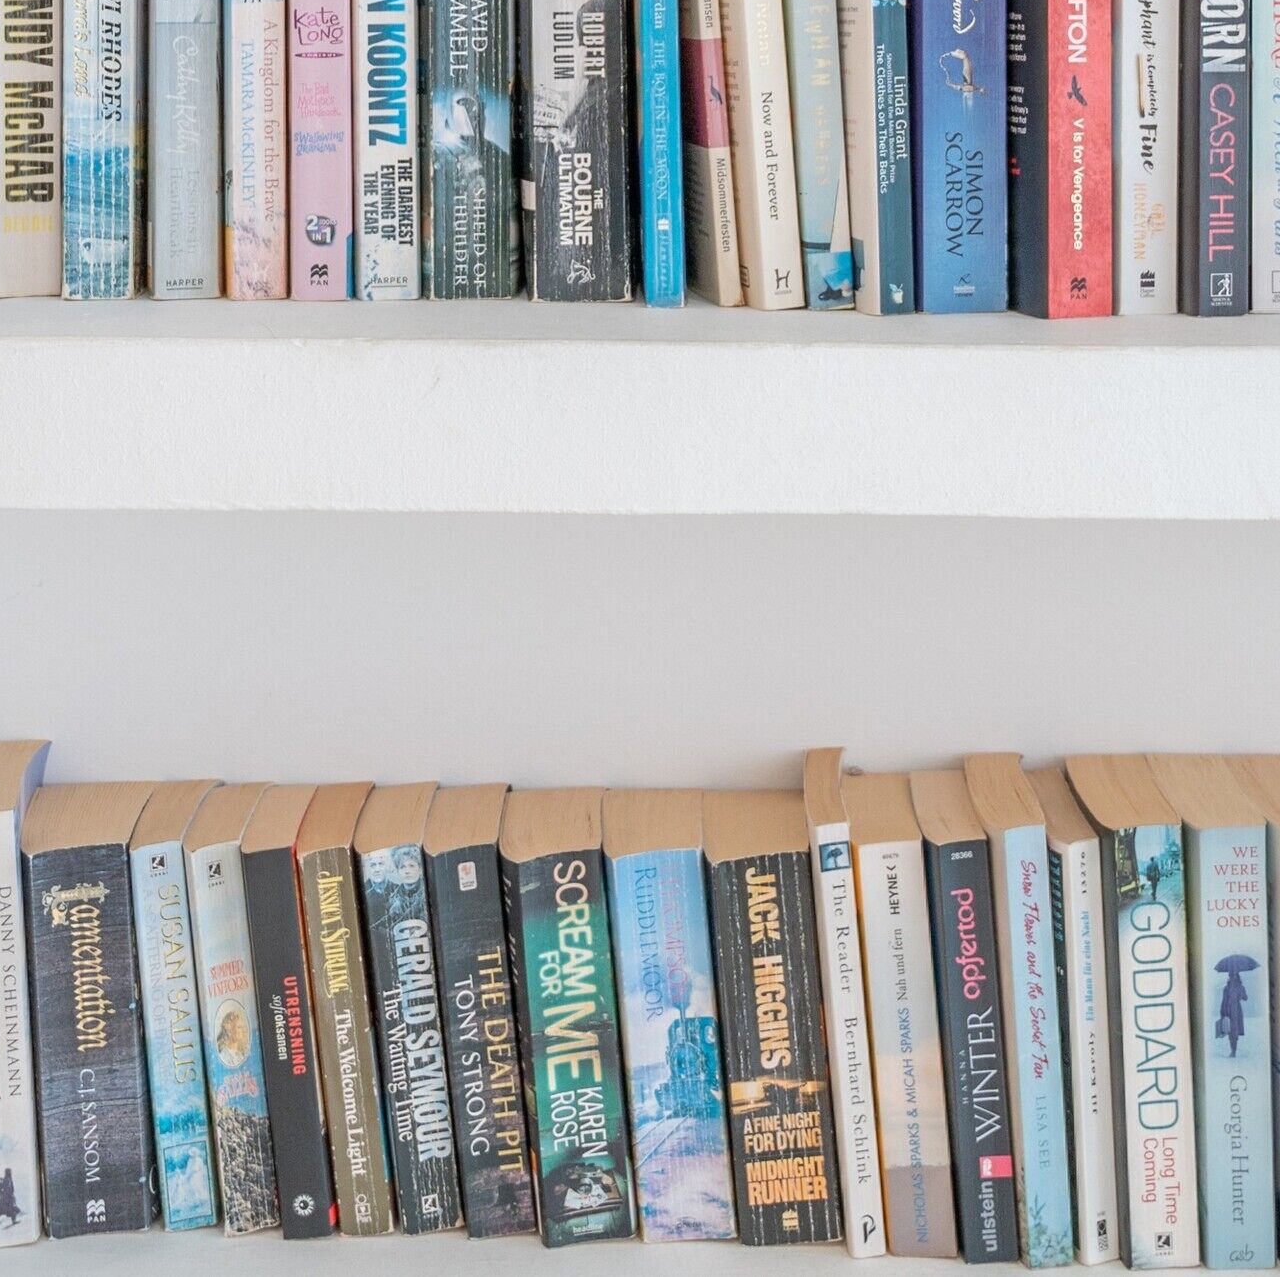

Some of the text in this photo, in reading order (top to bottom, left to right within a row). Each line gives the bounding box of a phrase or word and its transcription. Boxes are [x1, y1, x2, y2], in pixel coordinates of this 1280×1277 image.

[368, 24, 407, 145] KOONTZ
[553, 11, 574, 79] LUDLUM
[582, 12, 606, 78] ROBERT
[5, 82, 54, 203] McNAB
[894, 75, 908, 159] Linda Grant
[1209, 83, 1234, 185] CASEY
[364, 171, 379, 234] THE YEAR
[381, 164, 396, 240] EVENING OF
[398, 157, 413, 246] THE DARKEST
[558, 154, 574, 245] ULTIMATUM
[574, 153, 593, 245] BOURNE
[593, 188, 603, 209] THE
[716, 157, 732, 252] Midsommerfesten
[945, 132, 963, 257] SCARROW
[965, 151, 983, 235] SIMON
[1209, 195, 1234, 262] HILL
[1214, 864, 1259, 875] WERE
[1226, 881, 1259, 892] THE
[1232, 847, 1259, 858] WE
[553, 860, 597, 997] SCREAM
[951, 888, 983, 999] opfertod
[1206, 899, 1260, 910] LUCKY
[1217, 916, 1261, 927] ONES
[538, 950, 560, 997] FOR
[745, 867, 789, 1069] JACK HIGGINS
[3, 965, 21, 1097] SCHEINMANN
[283, 976, 306, 1075] UTRENSNING
[392, 918, 451, 1162] GERALD SEYMOUR
[542, 1001, 602, 1091] ME
[1130, 902, 1179, 1130] GODDARD
[477, 946, 524, 1173] THE DEATH PIT
[967, 1007, 1001, 1142] WINTER
[80, 1102, 100, 1183] SANSOM
[550, 1091, 579, 1152] ROSE
[576, 1087, 609, 1159] KAREN
[1141, 1138, 1160, 1203] Coming
[1161, 1137, 1180, 1224] Long Time
[981, 1181, 999, 1252] ullstein
